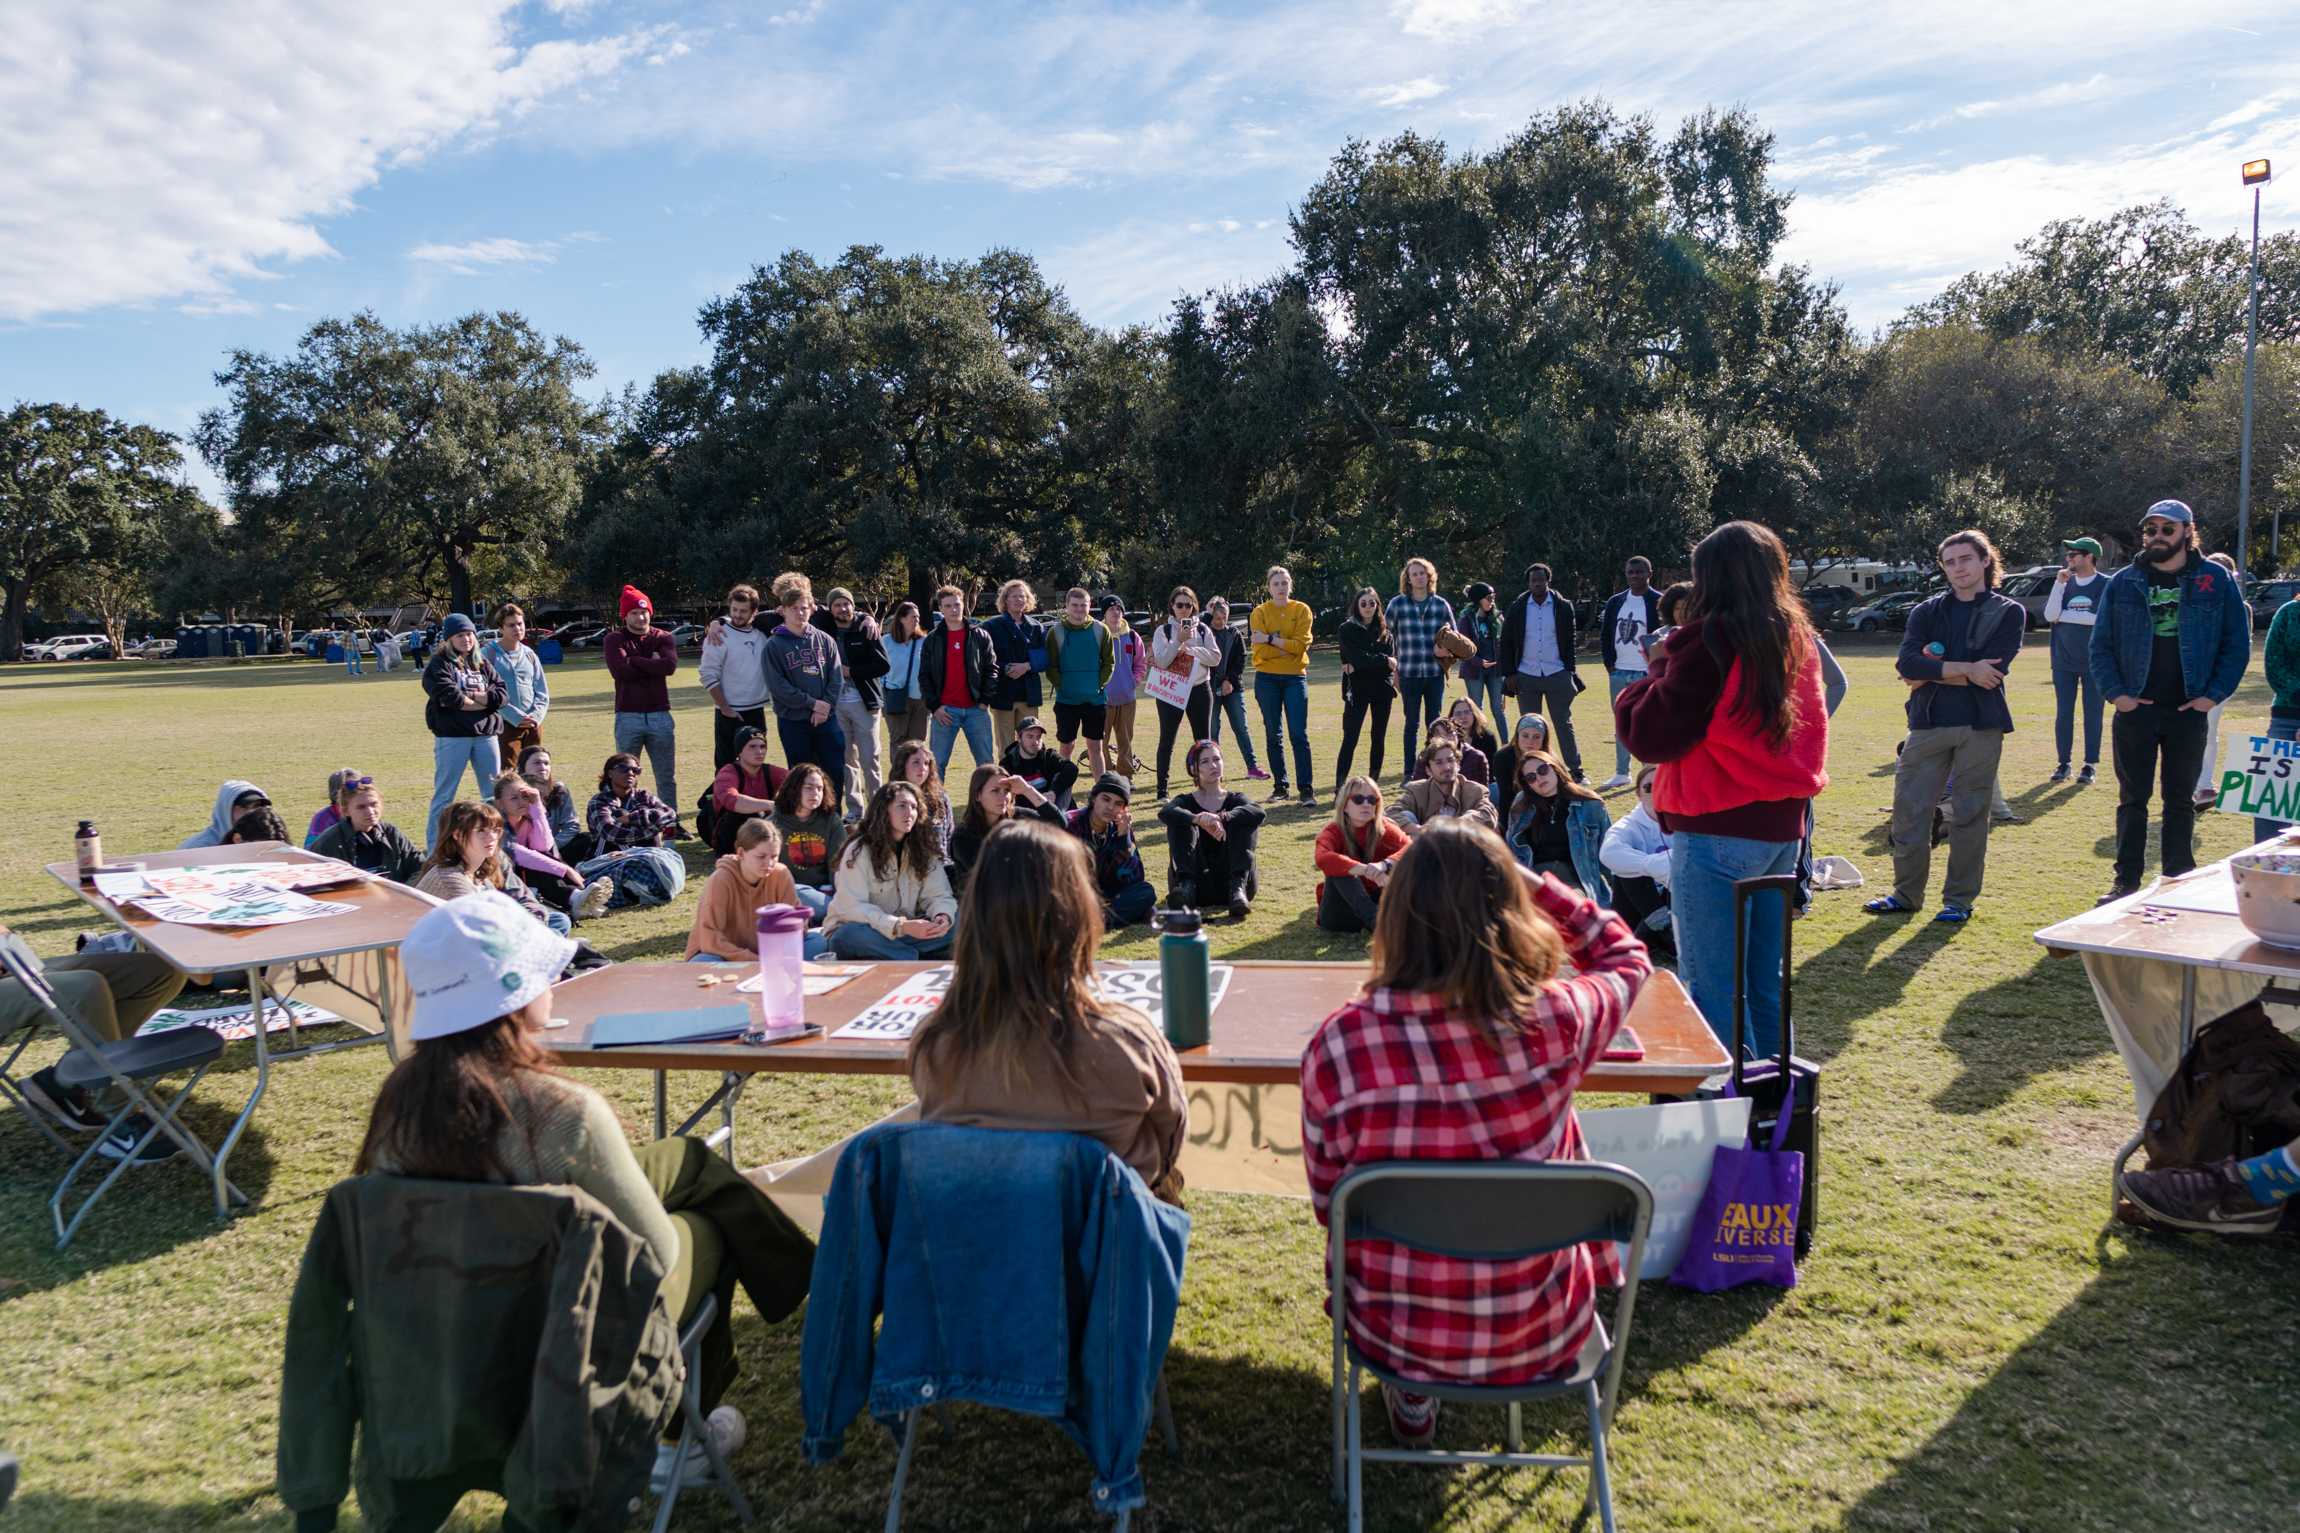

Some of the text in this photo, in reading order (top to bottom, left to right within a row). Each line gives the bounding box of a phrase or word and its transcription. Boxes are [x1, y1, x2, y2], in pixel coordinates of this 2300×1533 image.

[1159, 675, 1178, 690] WE
[2247, 755, 2293, 778] IS
[2215, 770, 2300, 821] PLAN
